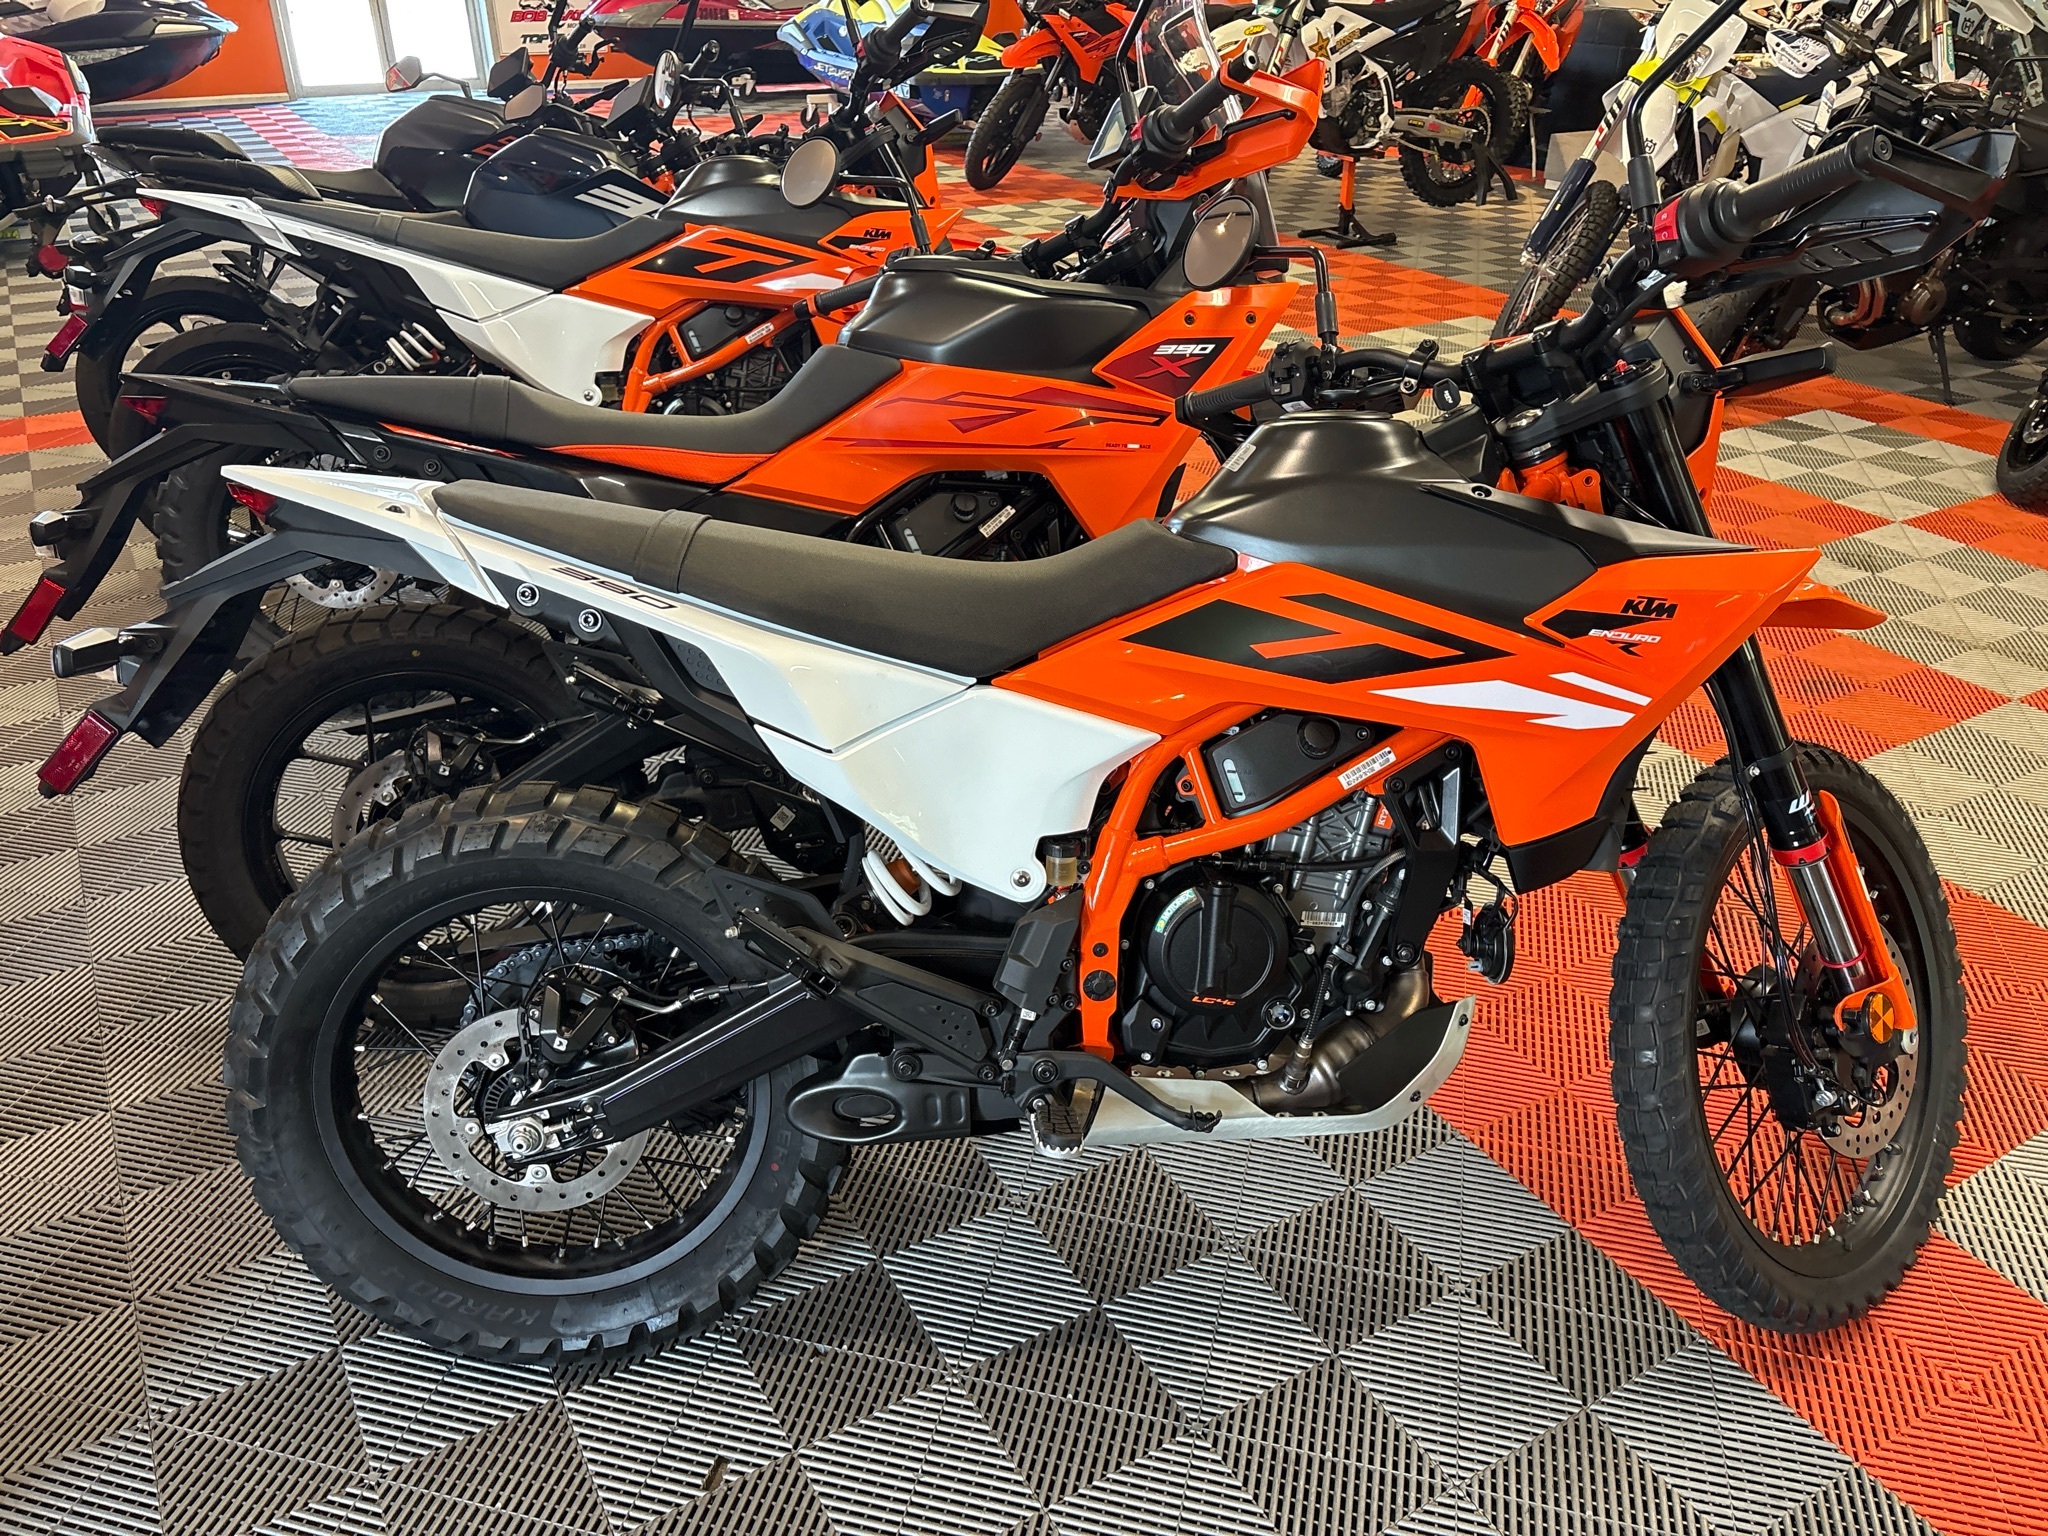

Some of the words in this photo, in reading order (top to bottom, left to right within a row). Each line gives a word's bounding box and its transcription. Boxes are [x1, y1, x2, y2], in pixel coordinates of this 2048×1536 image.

[863, 227, 892, 240] KTM
[1153, 343, 1216, 355] 390
[1134, 357, 1204, 379] X
[550, 566, 679, 610] 390
[1620, 595, 1679, 619] KTM
[1588, 628, 1662, 643] ENDURO
[1160, 889, 1194, 920] MOTOREX
[407, 1279, 542, 1327] KAROO
